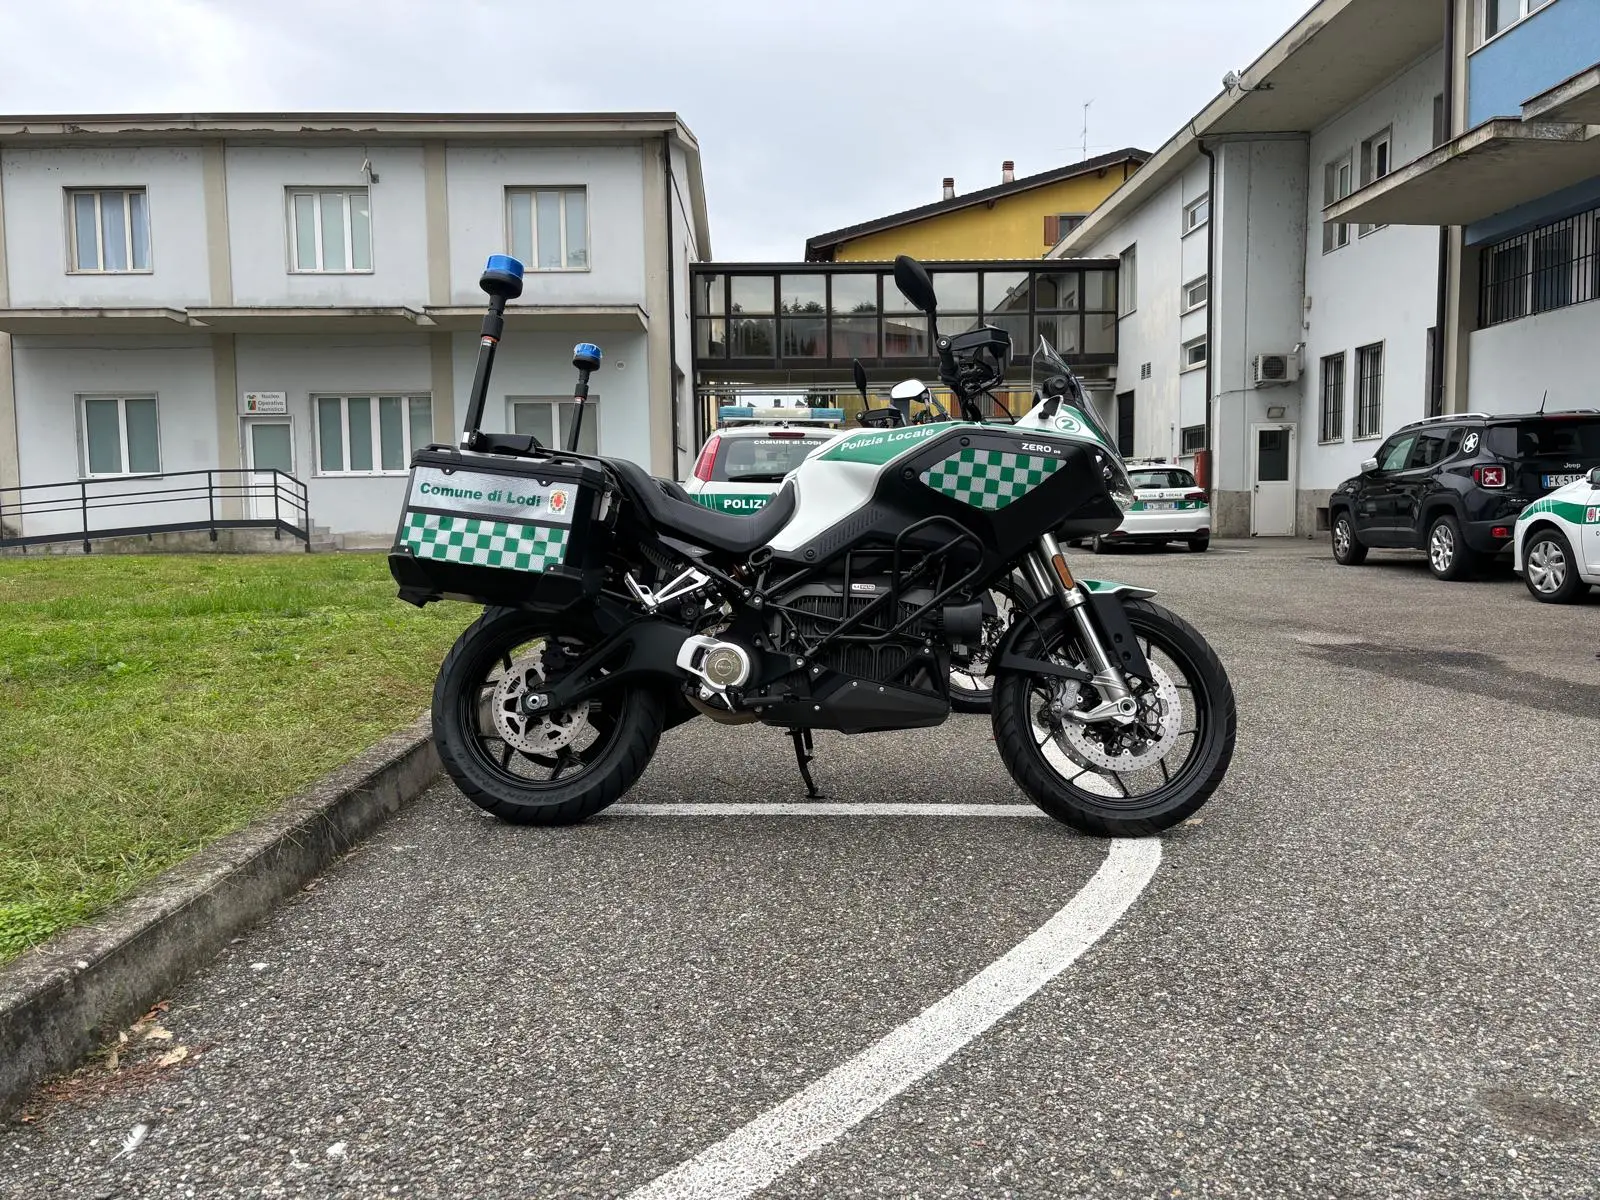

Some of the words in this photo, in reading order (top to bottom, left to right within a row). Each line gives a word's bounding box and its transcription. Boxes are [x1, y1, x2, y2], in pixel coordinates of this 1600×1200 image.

[1061, 419, 1075, 430] 2
[840, 436, 884, 452] Polizia
[887, 428, 935, 442] Locale
[1021, 442, 1052, 453] ZERO
[420, 482, 483, 500] Comune
[487, 489, 502, 502] di
[506, 492, 542, 507] Lodi
